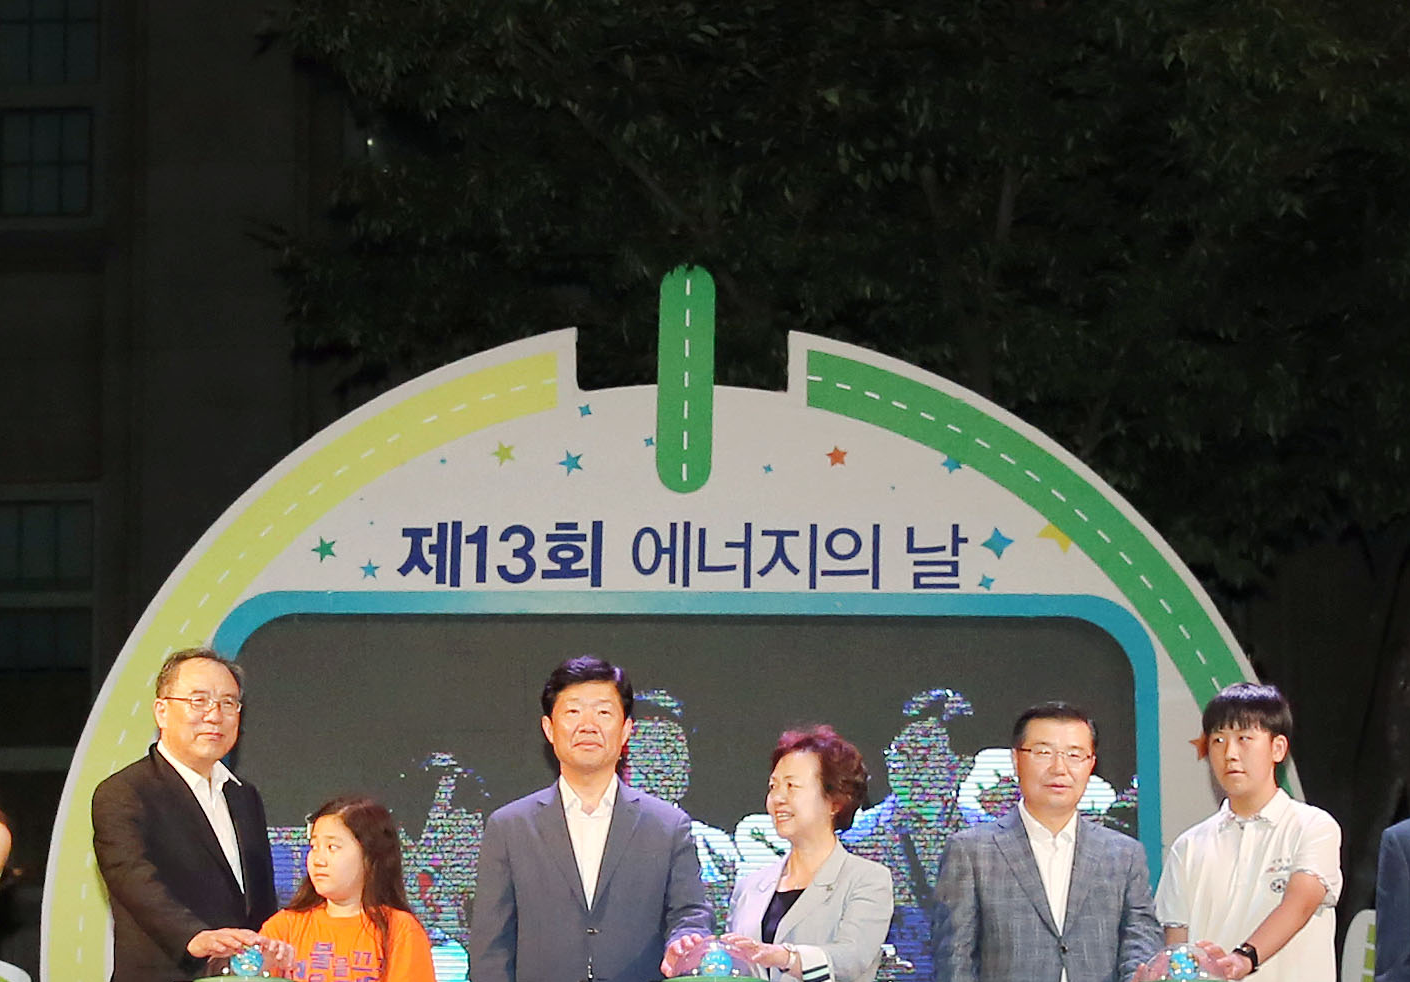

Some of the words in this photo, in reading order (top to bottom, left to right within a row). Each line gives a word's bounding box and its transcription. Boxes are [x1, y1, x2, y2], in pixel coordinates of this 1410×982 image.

[396, 520, 603, 588] 제13회
[631, 521, 881, 589] 에너지의
[906, 523, 968, 590] 날
